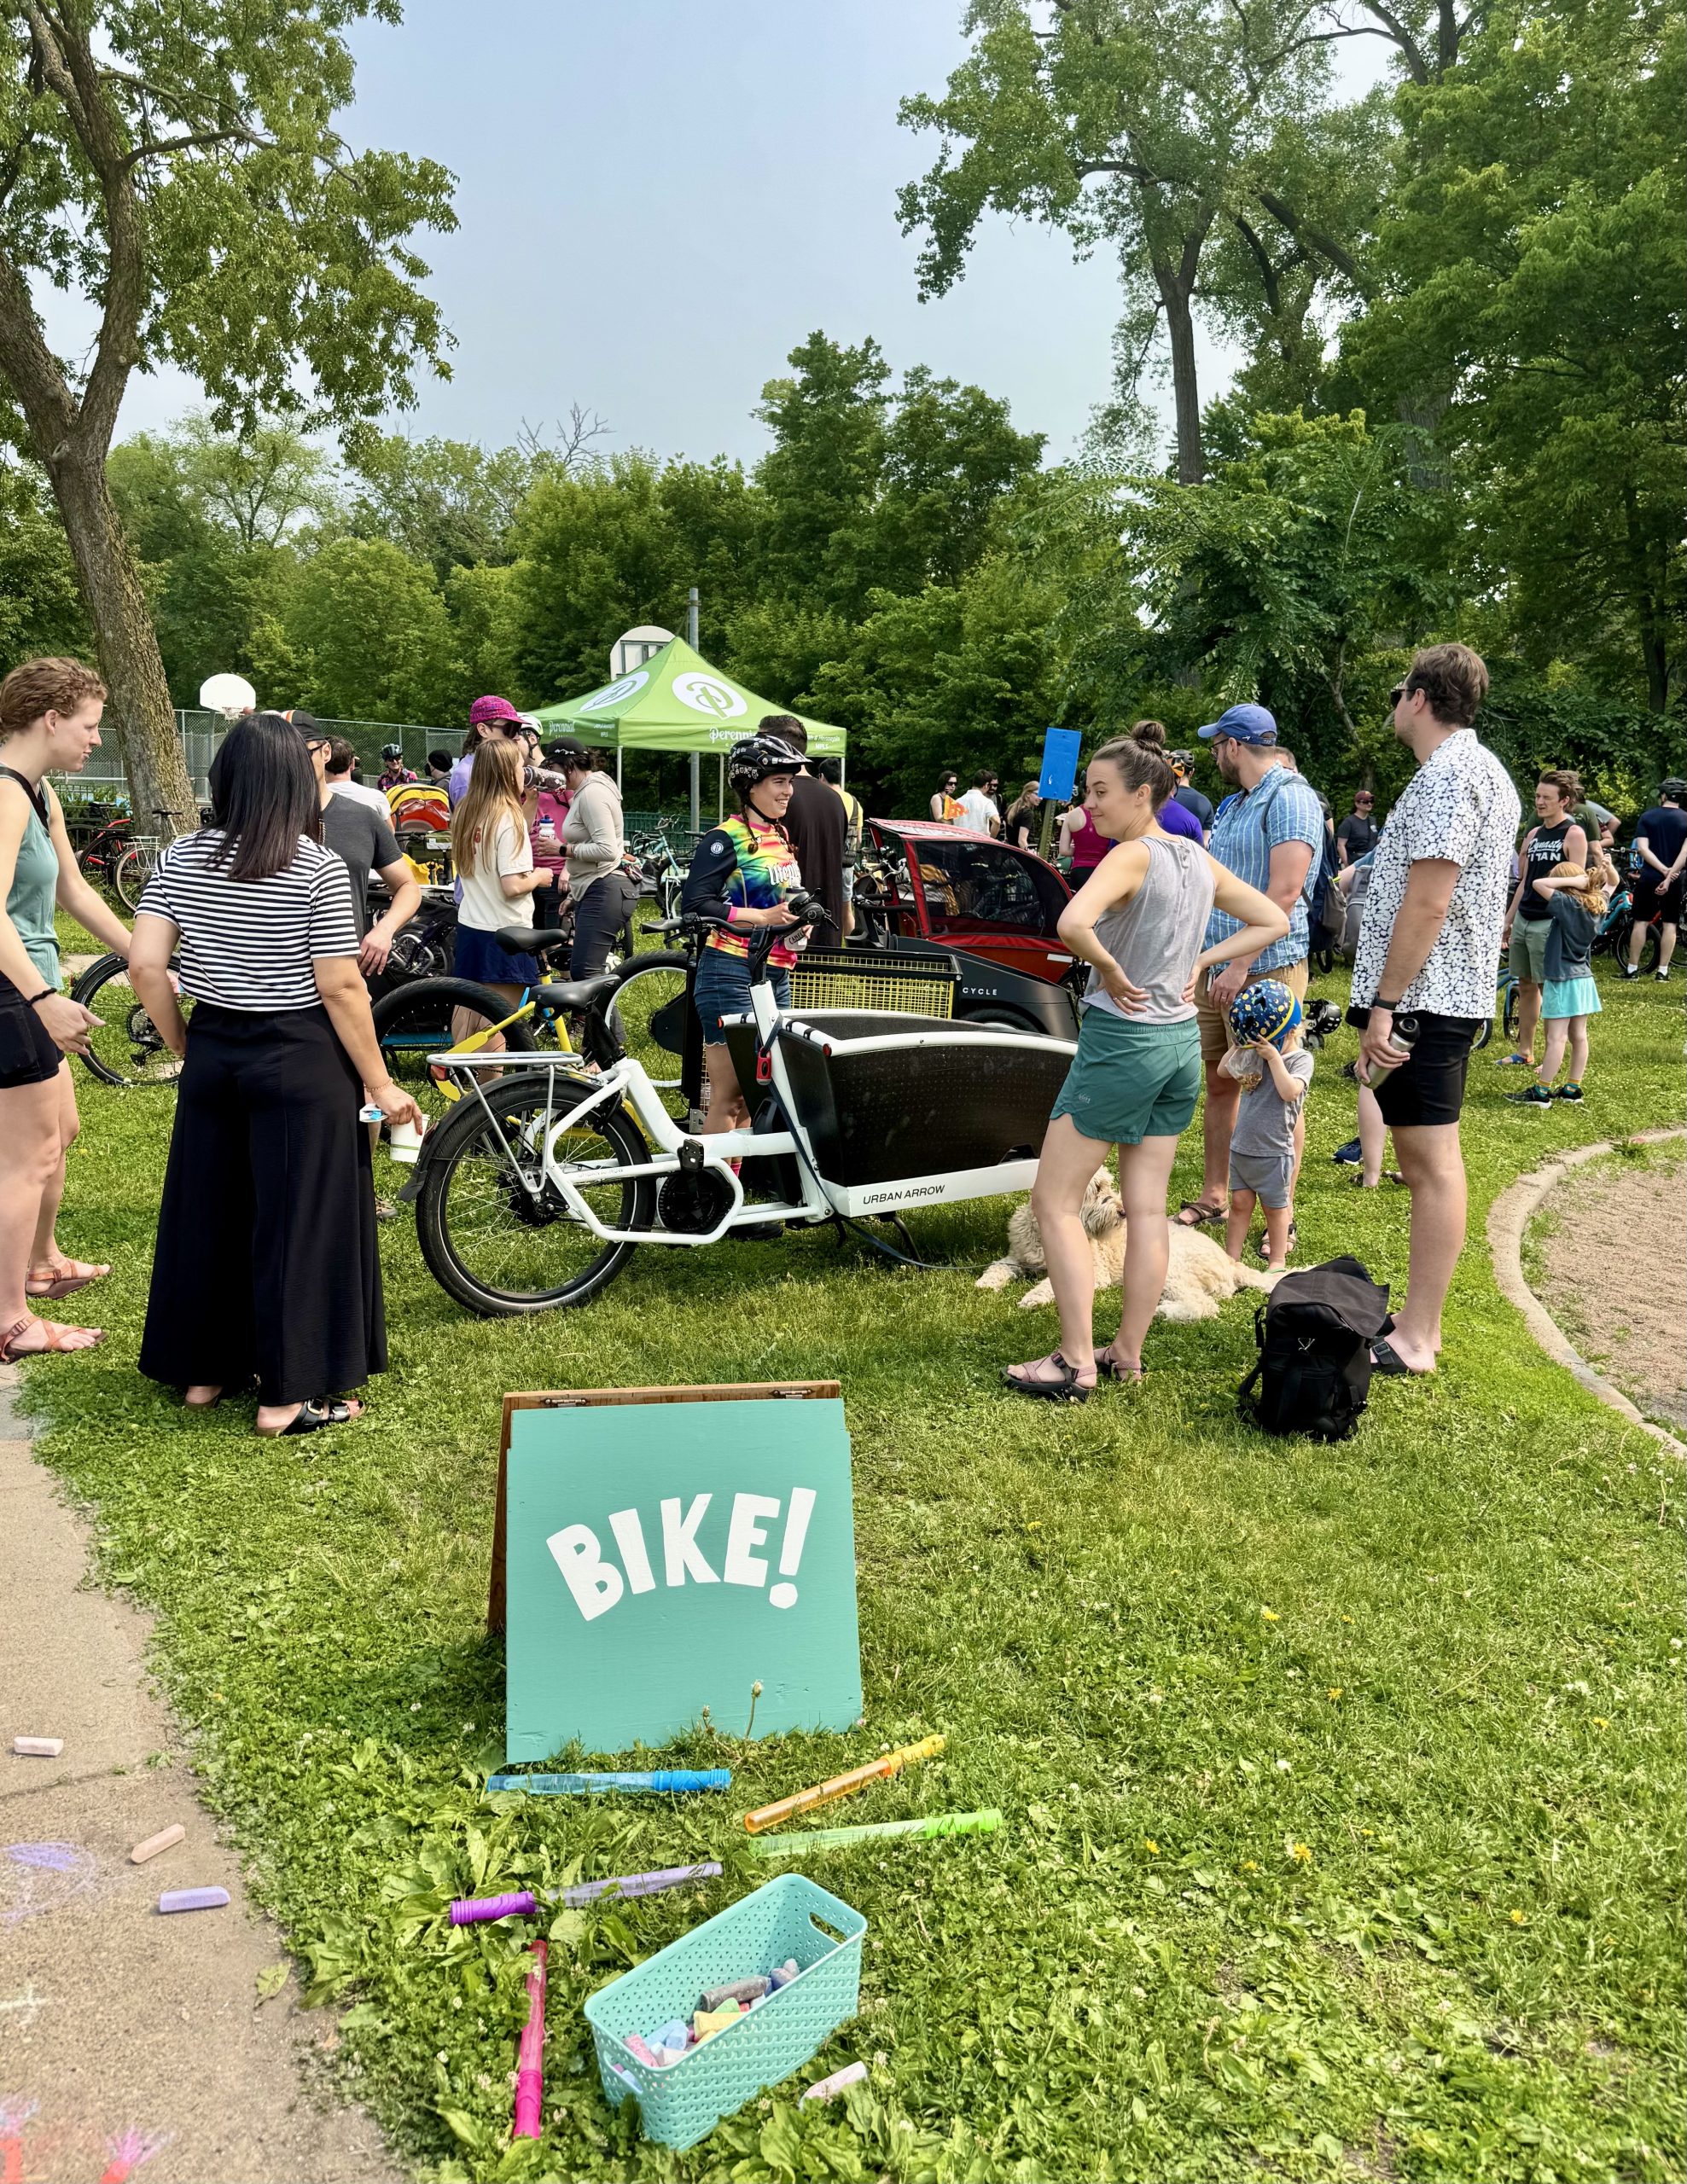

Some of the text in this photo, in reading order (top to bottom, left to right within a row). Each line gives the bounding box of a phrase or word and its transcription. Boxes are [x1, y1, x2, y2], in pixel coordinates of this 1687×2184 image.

[709, 727, 756, 743] Perenni
[962, 986, 998, 996] CYCLE
[863, 1184, 945, 1205] URBAN ARROW
[545, 1486, 817, 1622] BIKE!
